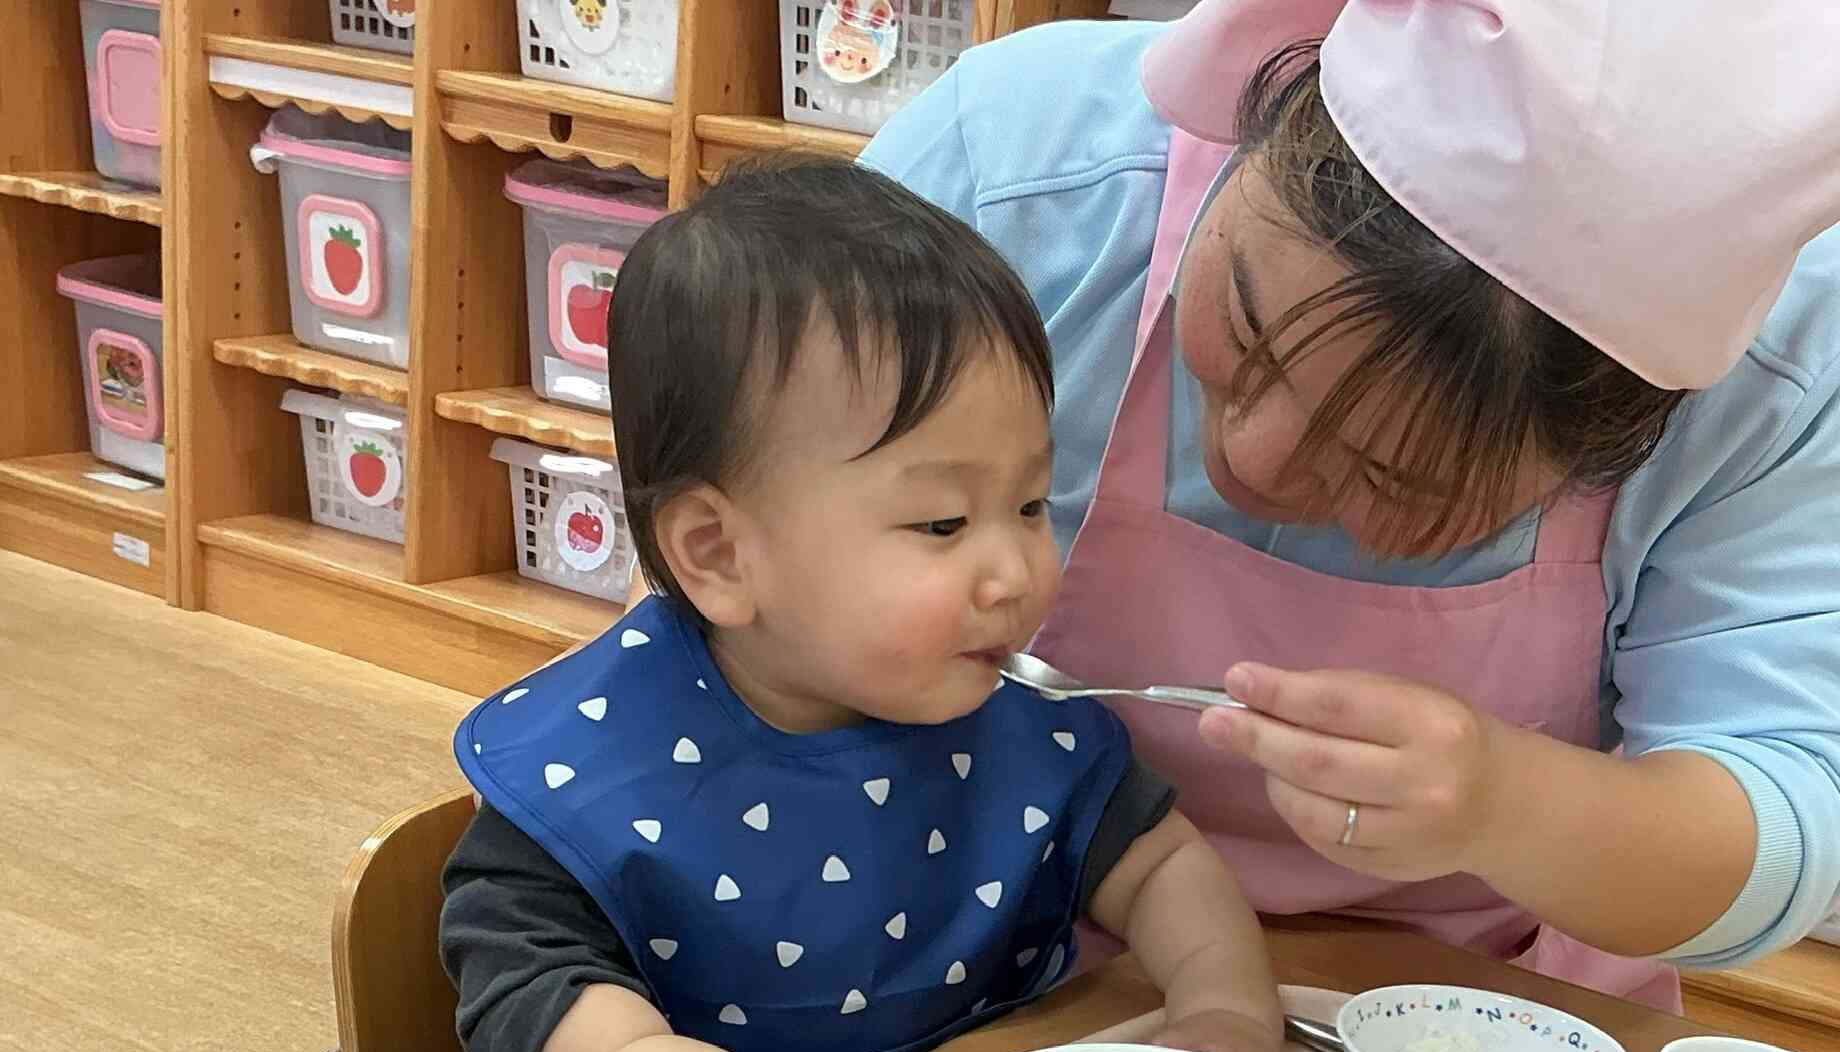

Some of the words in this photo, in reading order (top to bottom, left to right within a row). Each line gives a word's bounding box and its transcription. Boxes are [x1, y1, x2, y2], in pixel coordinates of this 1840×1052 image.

[1395, 1002, 1406, 1016] K
[1422, 994, 1431, 1009] L
[1447, 997, 1462, 1011] M
[1487, 1007, 1502, 1023] N
[1520, 1012, 1533, 1025] O
[1568, 1031, 1581, 1048] Q
